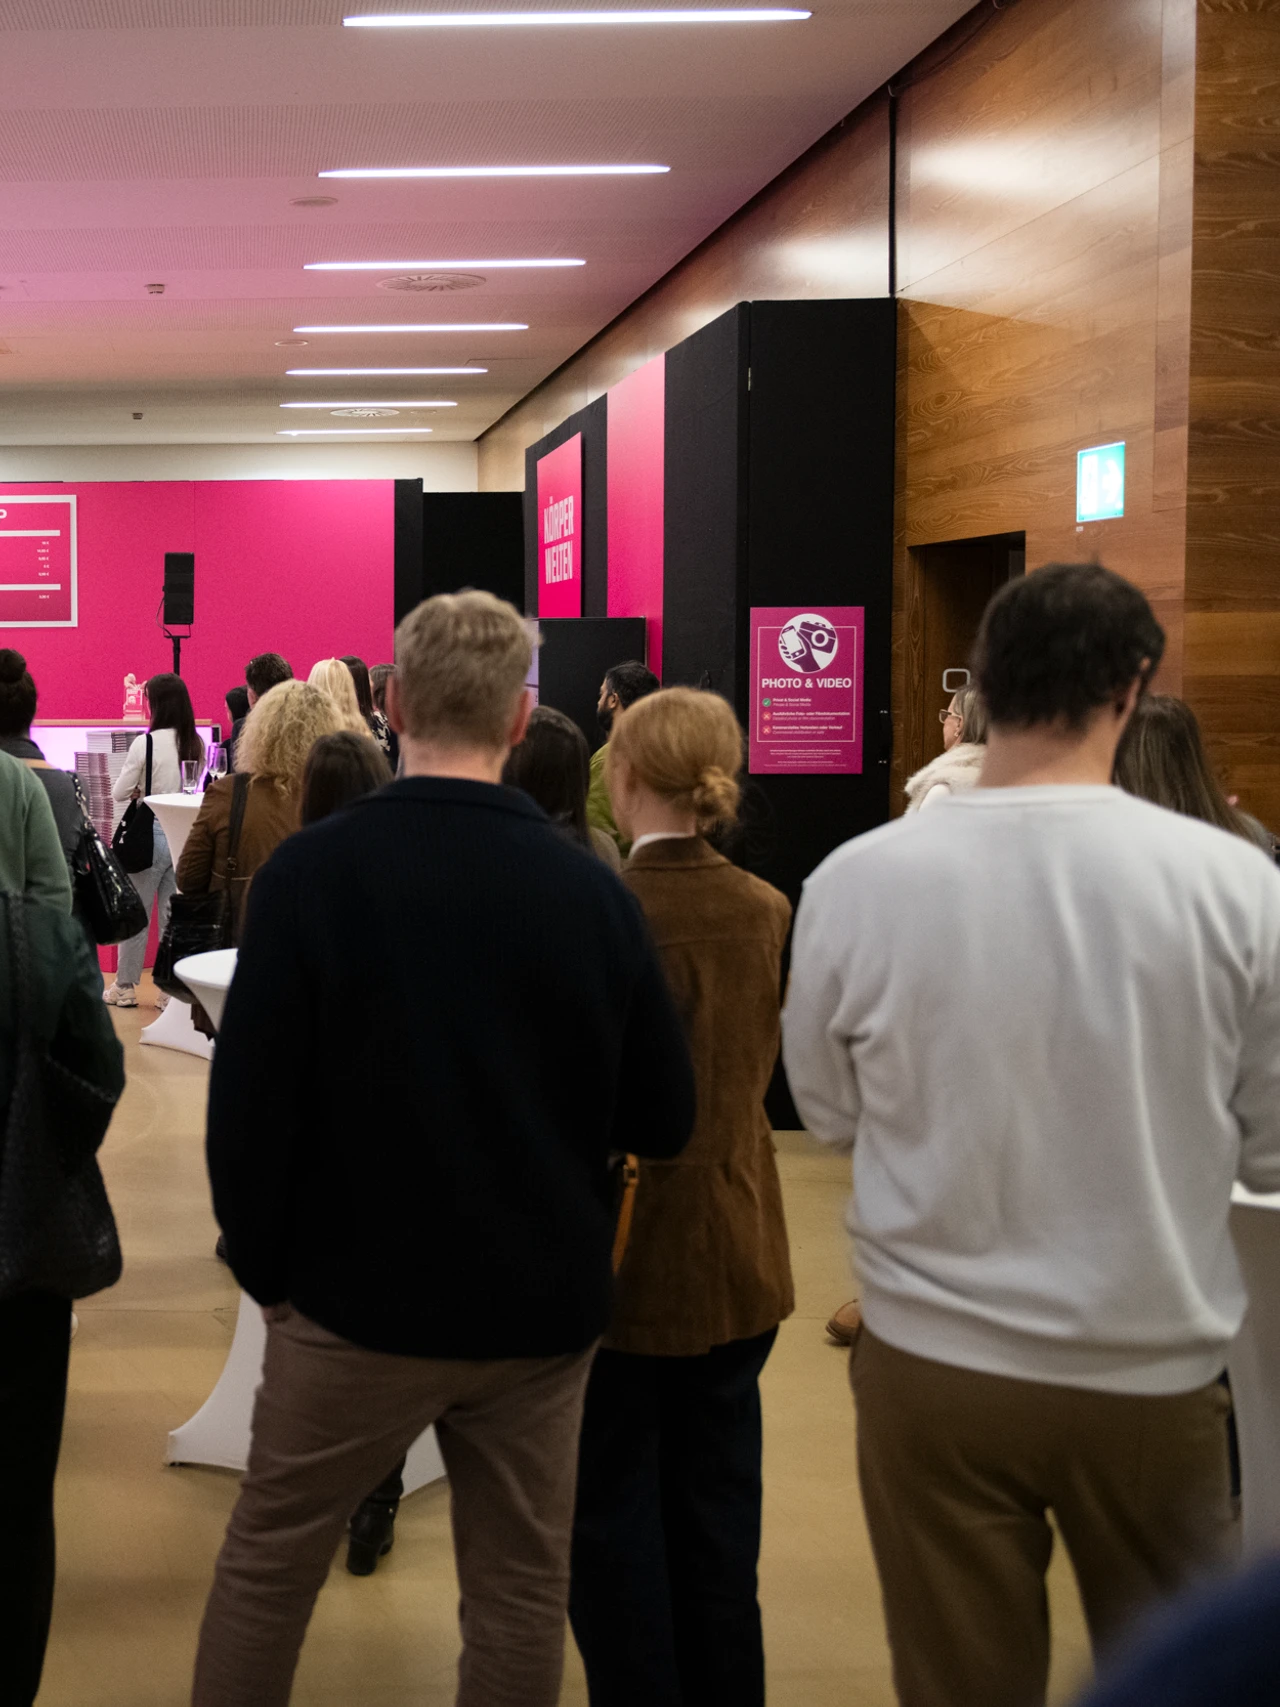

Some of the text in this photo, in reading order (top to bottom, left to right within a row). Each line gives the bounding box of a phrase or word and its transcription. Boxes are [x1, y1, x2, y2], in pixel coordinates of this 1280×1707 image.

[544, 495, 574, 544] KÖRPER
[545, 539, 573, 584] WELTEN
[761, 678, 852, 689] PHOTO & VIDEO
